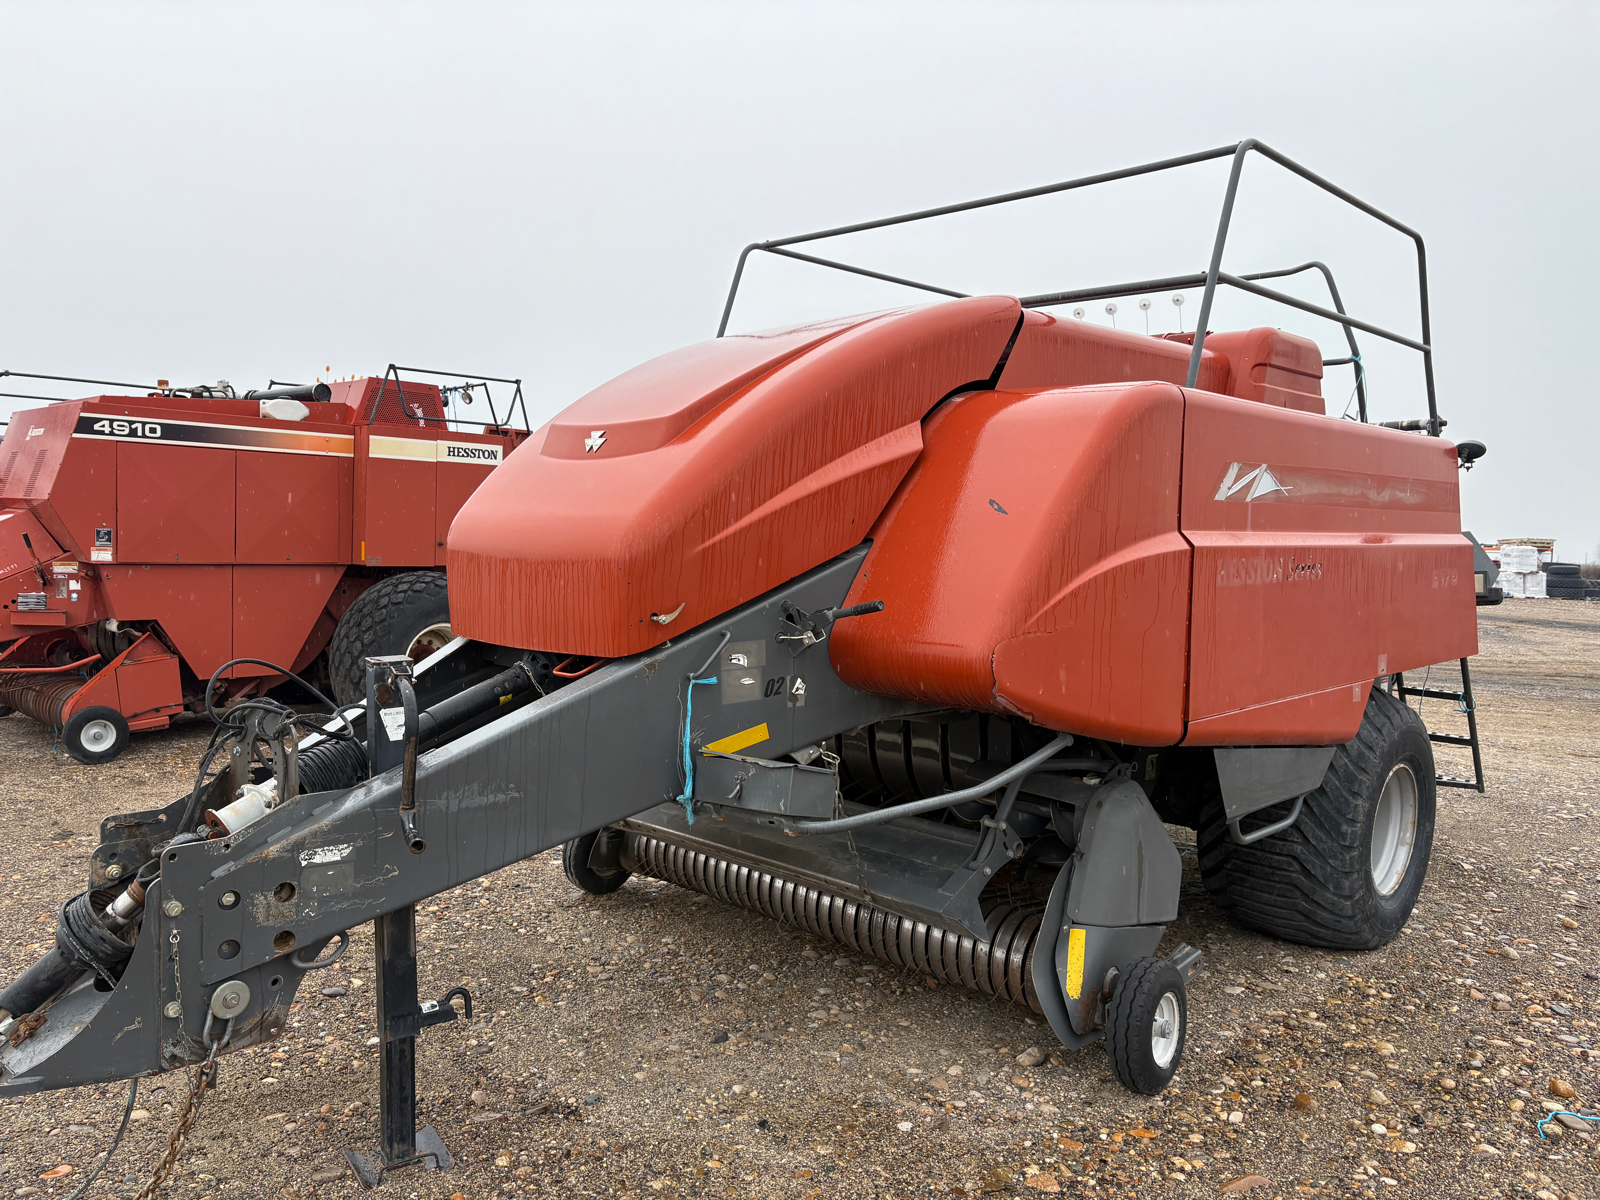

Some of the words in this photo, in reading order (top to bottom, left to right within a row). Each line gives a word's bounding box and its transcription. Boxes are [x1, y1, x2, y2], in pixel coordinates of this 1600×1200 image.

[93, 419, 161, 438] 4910
[447, 446, 498, 460] HESSTON
[1286, 554, 1322, 582] Series
[764, 676, 785, 698] 02
